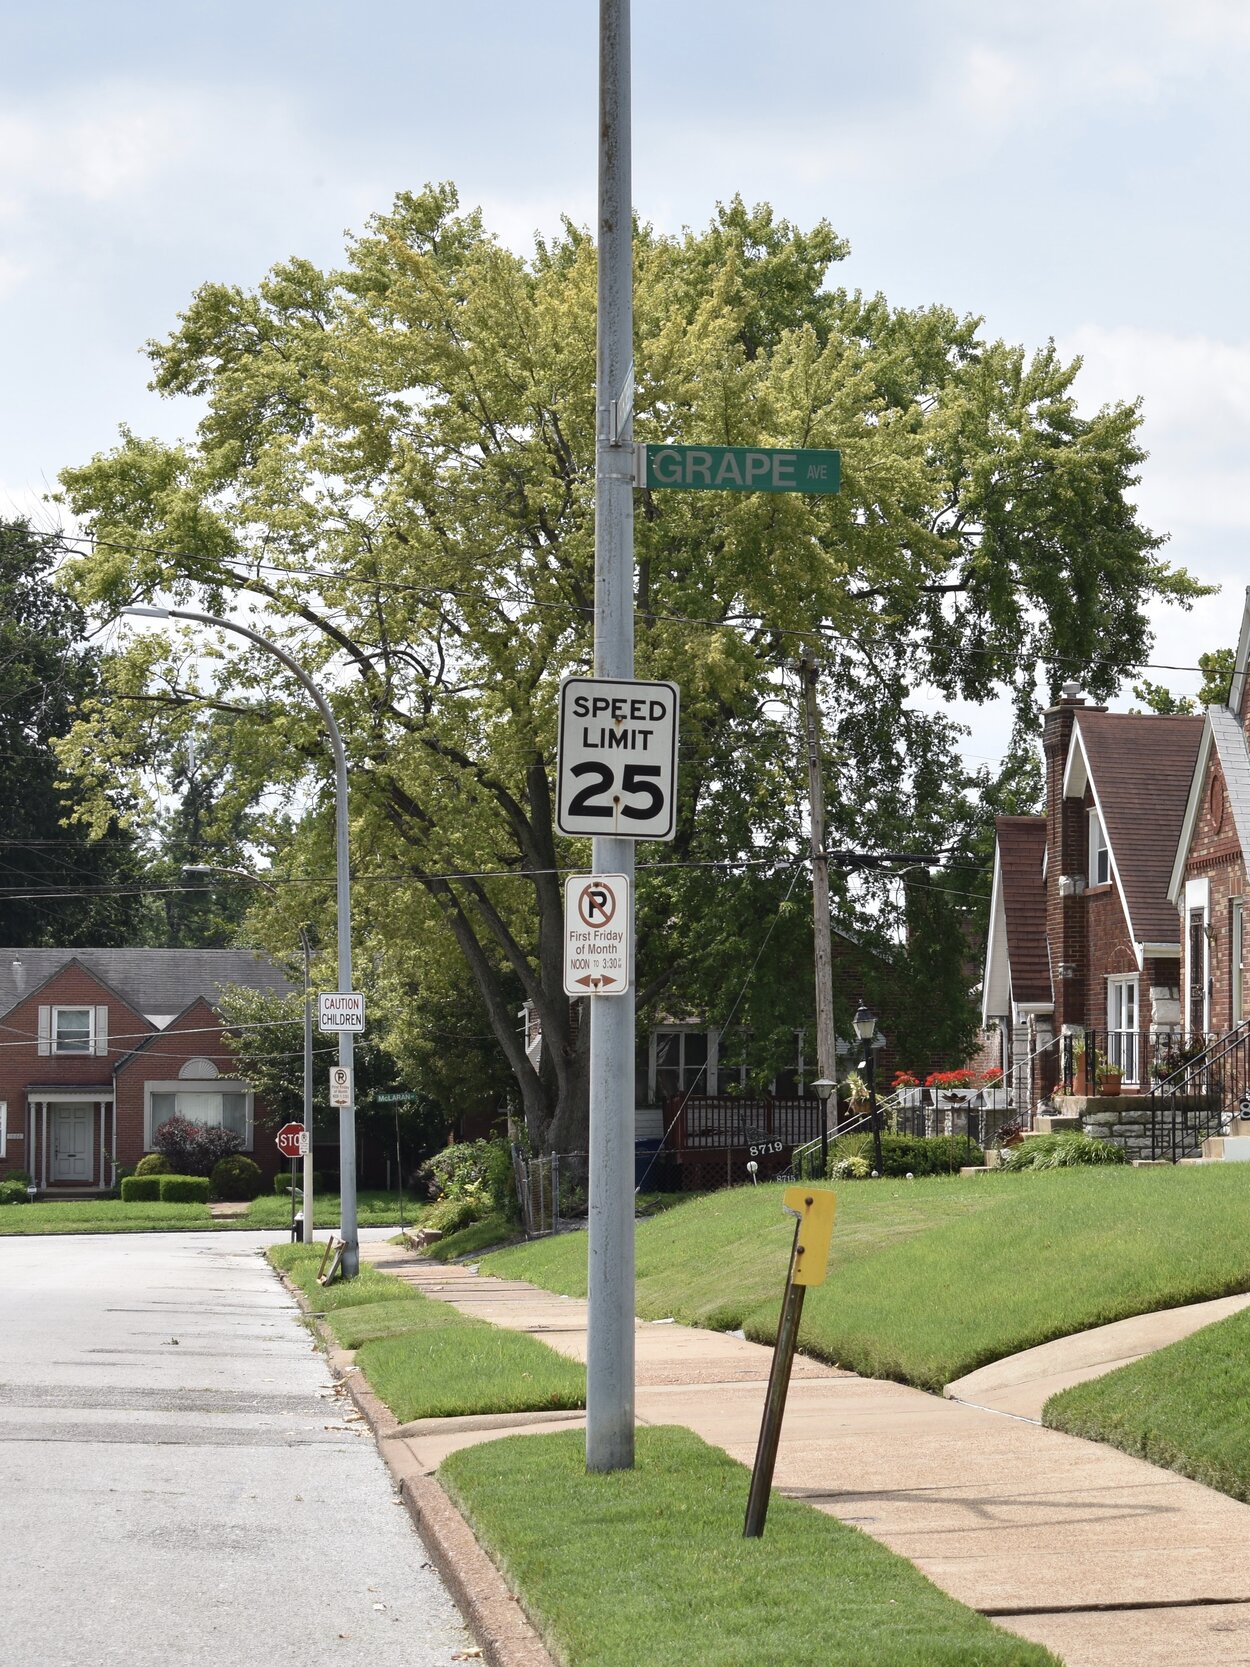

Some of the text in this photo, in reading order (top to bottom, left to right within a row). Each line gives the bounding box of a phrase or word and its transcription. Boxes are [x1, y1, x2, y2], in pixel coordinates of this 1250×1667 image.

[653, 450, 828, 487] GRAPE AVE
[572, 696, 667, 721] SPEED
[583, 727, 653, 750] LIMIT
[568, 761, 664, 820] 25
[569, 930, 623, 943] First Friday
[576, 944, 617, 954] of Month
[571, 959, 590, 970] NOON
[324, 998, 359, 1010] CAUTION
[322, 1014, 361, 1025] CHILDREN
[280, 1134, 300, 1146] STO
[750, 1141, 783, 1156] 8719
[776, 1174, 796, 1183] 8715
